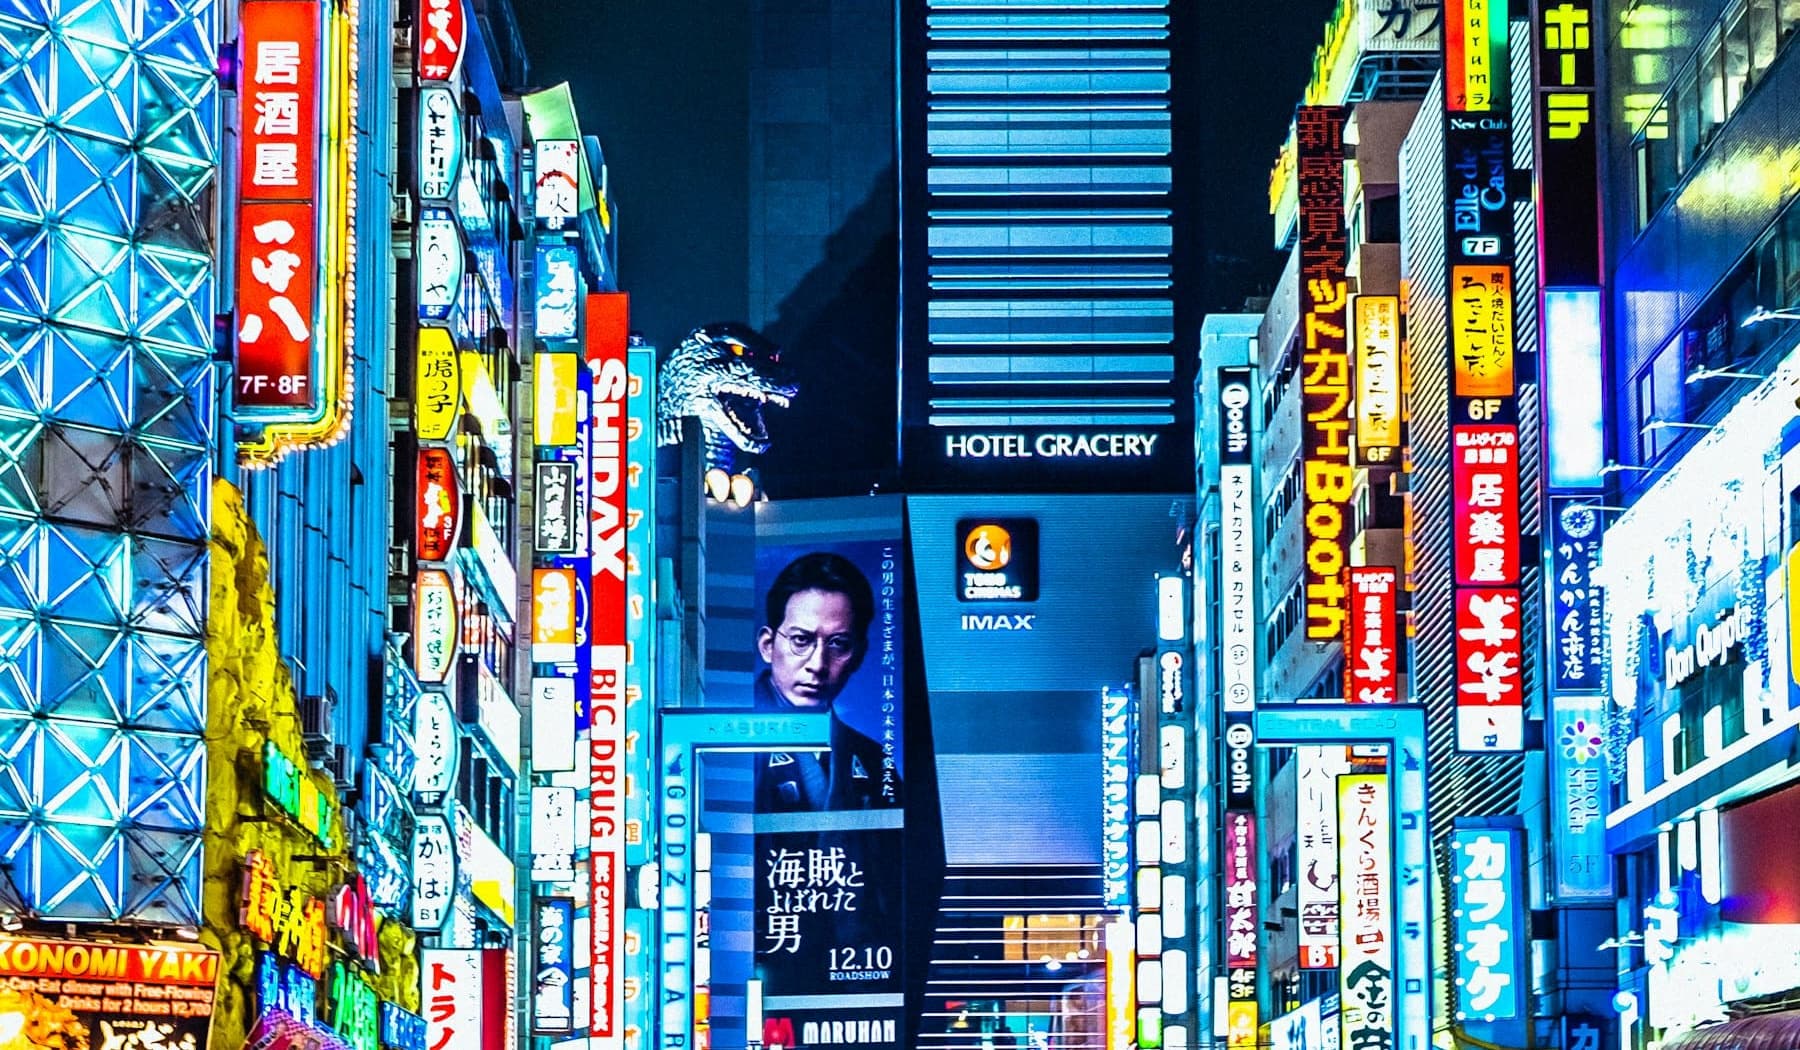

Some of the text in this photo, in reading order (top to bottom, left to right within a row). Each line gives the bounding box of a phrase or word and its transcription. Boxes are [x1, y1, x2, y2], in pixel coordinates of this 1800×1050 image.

[424, 65, 448, 76] 7F
[253, 41, 301, 186] 居酒屋
[1451, 118, 1507, 130] New Club
[423, 181, 450, 195] 6F
[1455, 150, 1481, 232] Elle de
[1467, 241, 1495, 252] 7F
[239, 219, 310, 344] つぼ八
[426, 304, 444, 316] 5F
[1468, 398, 1502, 420] 6F
[946, 433, 1158, 458] HOTEL GRACERY
[1366, 446, 1391, 462] 6F
[592, 358, 628, 582] SHIDAX
[961, 614, 1034, 631] IMAX
[881, 546, 896, 804] この男の生きざまが、日本の未来を変えた。
[1665, 645, 1695, 690] Don
[592, 669, 616, 838] BIC DRUG
[420, 791, 442, 804] 1F
[766, 847, 865, 889] 海賊と
[666, 785, 687, 1004] GODZILLA
[766, 887, 858, 914] よばれた
[765, 914, 802, 954] 男
[1463, 836, 1511, 1011] カラオケ
[140, 950, 217, 982] YAKI
[829, 945, 893, 971] 12.10
[829, 970, 891, 981] ROADSHOW
[1230, 969, 1255, 981] 4F
[134, 984, 213, 1003] Free-Flowing
[1230, 984, 1255, 998] 3F
[60, 995, 100, 1011] Drinks
[102, 997, 122, 1012] for
[122, 998, 133, 1012] 2
[133, 999, 170, 1015] hours
[803, 1020, 896, 1045] MARUHAN
